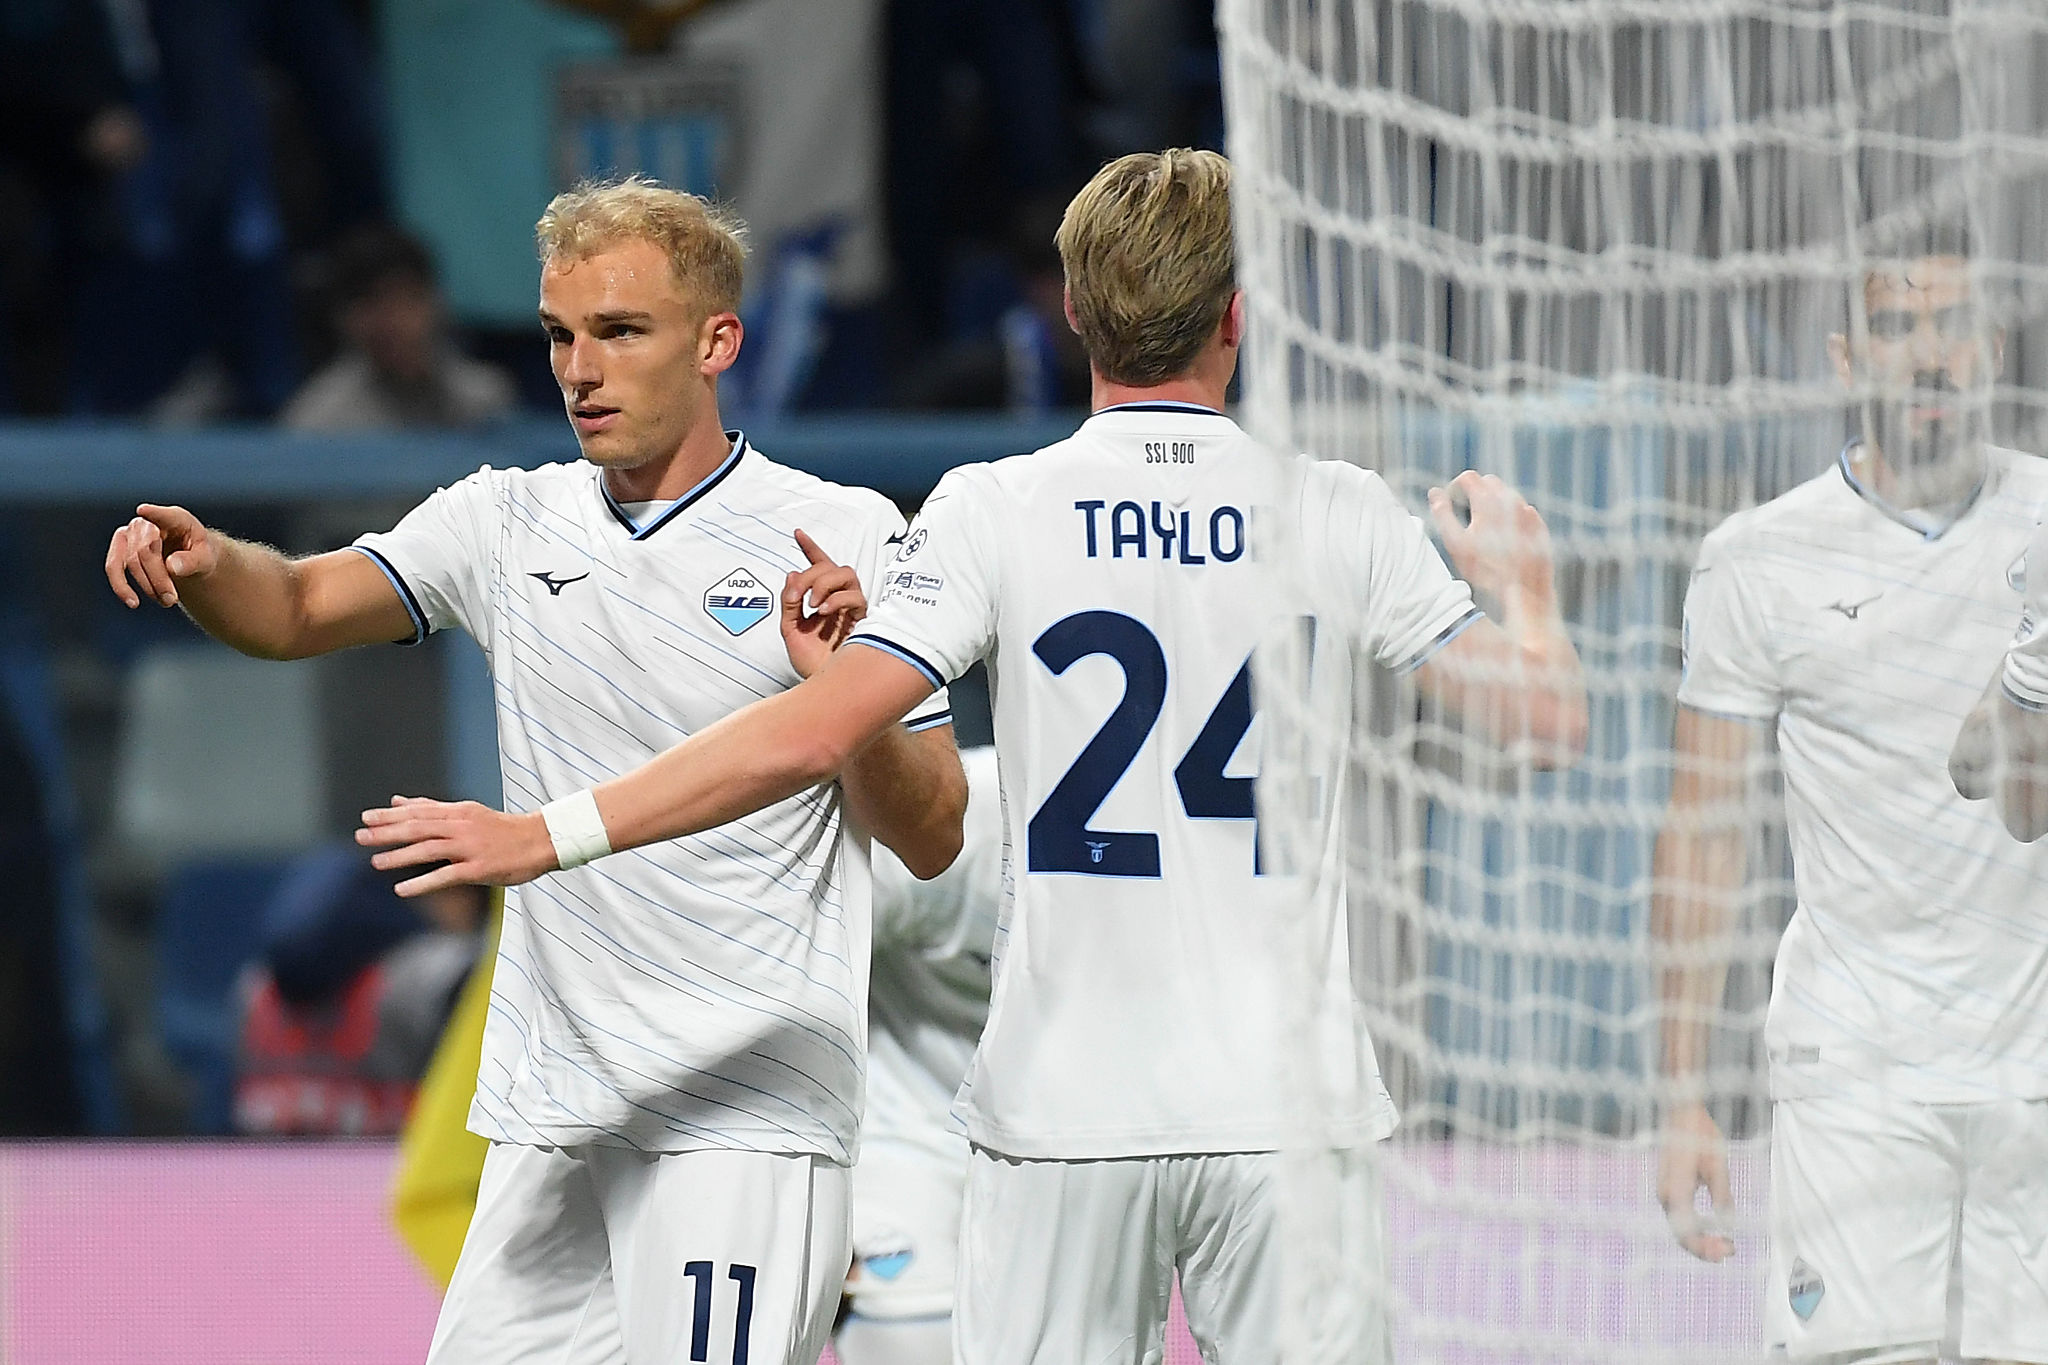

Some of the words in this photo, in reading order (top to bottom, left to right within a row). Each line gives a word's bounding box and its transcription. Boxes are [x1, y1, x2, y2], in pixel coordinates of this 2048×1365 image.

[1145, 443, 1168, 464] SSL
[1172, 443, 1194, 464] 900
[1074, 500, 1256, 566] TAYLO
[727, 579, 755, 588] LAZIO
[1026, 608, 1317, 880] 24
[683, 1260, 757, 1365] 11
